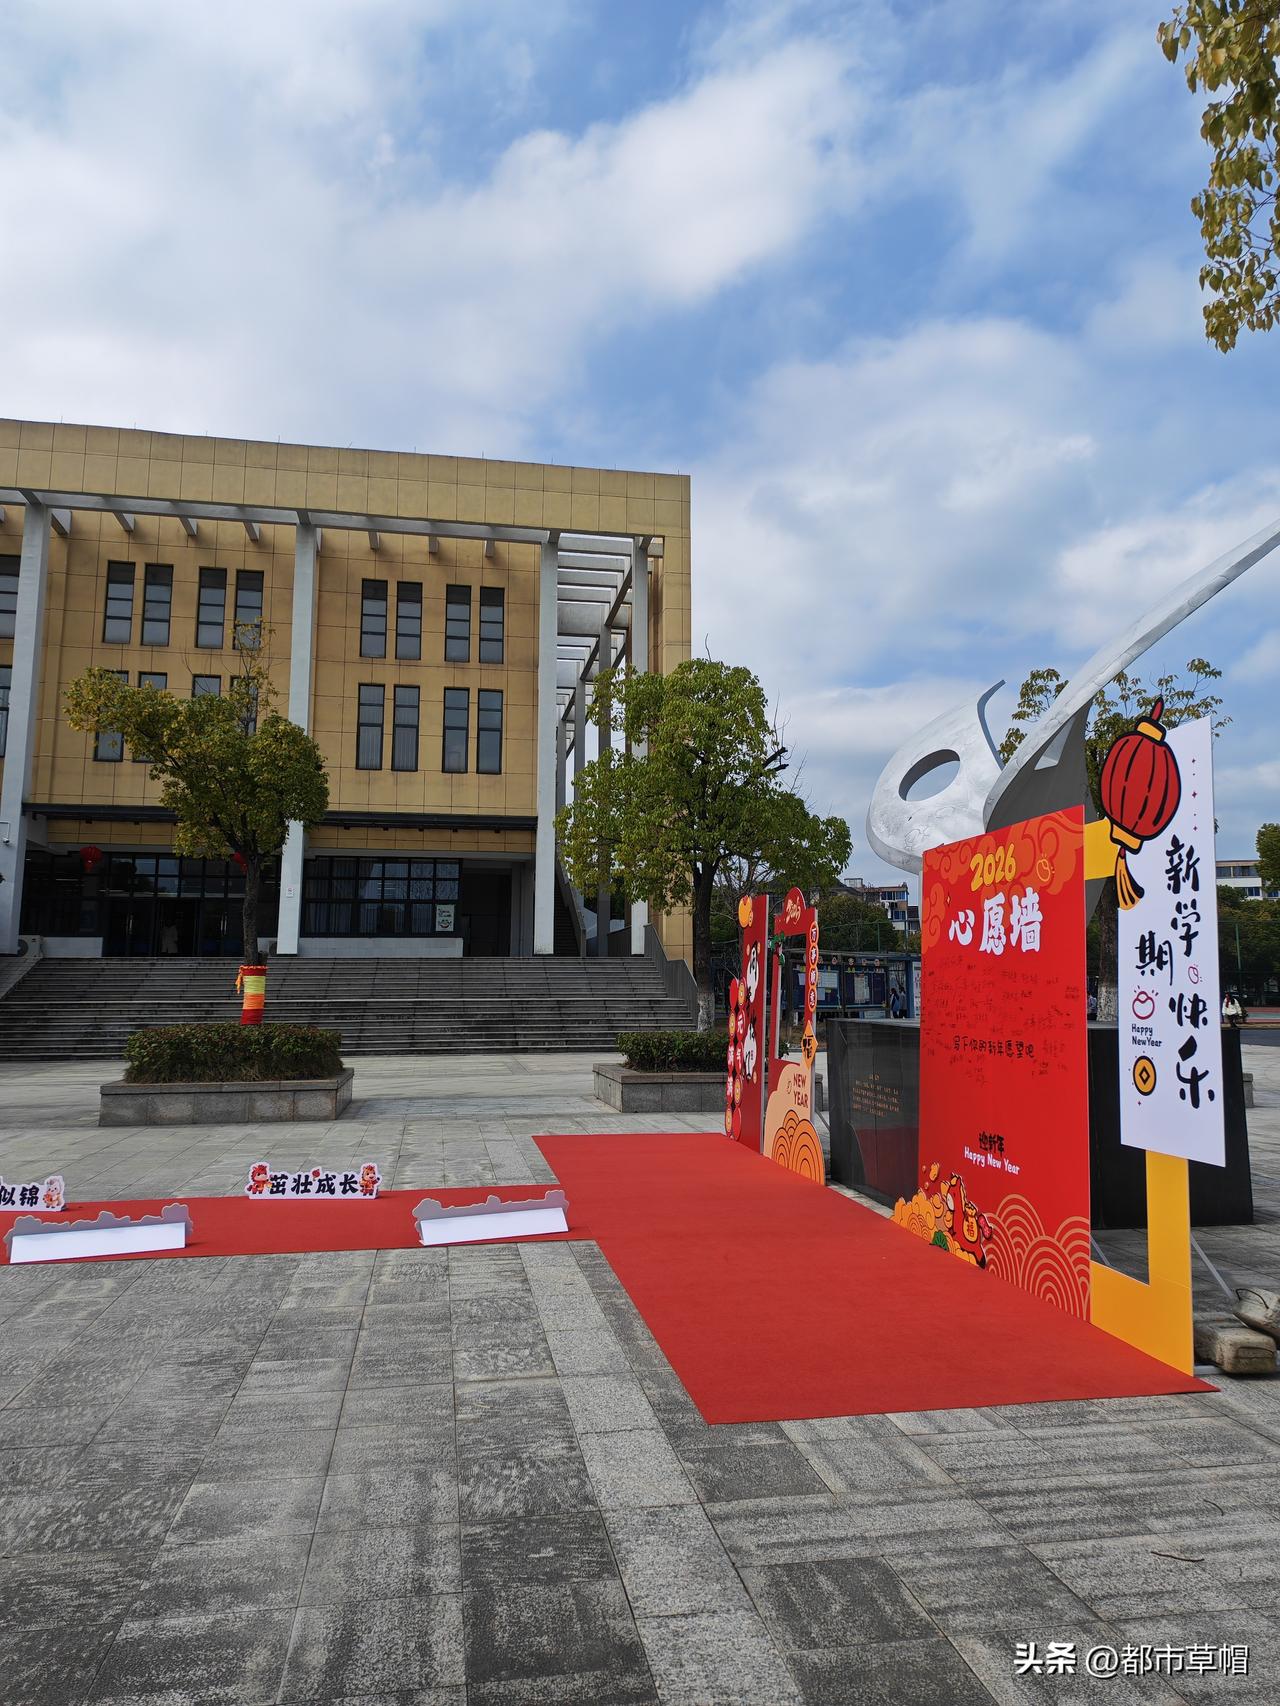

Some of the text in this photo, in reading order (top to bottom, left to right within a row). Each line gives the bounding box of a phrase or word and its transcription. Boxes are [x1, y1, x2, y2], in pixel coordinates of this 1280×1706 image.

[970, 843, 1016, 892] 2026
[949, 887, 1043, 956] 心愿墙
[1132, 1023, 1153, 1037] Happy
[793, 1073, 807, 1089] NEW
[794, 1091, 809, 1109] YEAR
[964, 1146, 1021, 1175] Happy New Year
[269, 1174, 359, 1196] 茁壮成长
